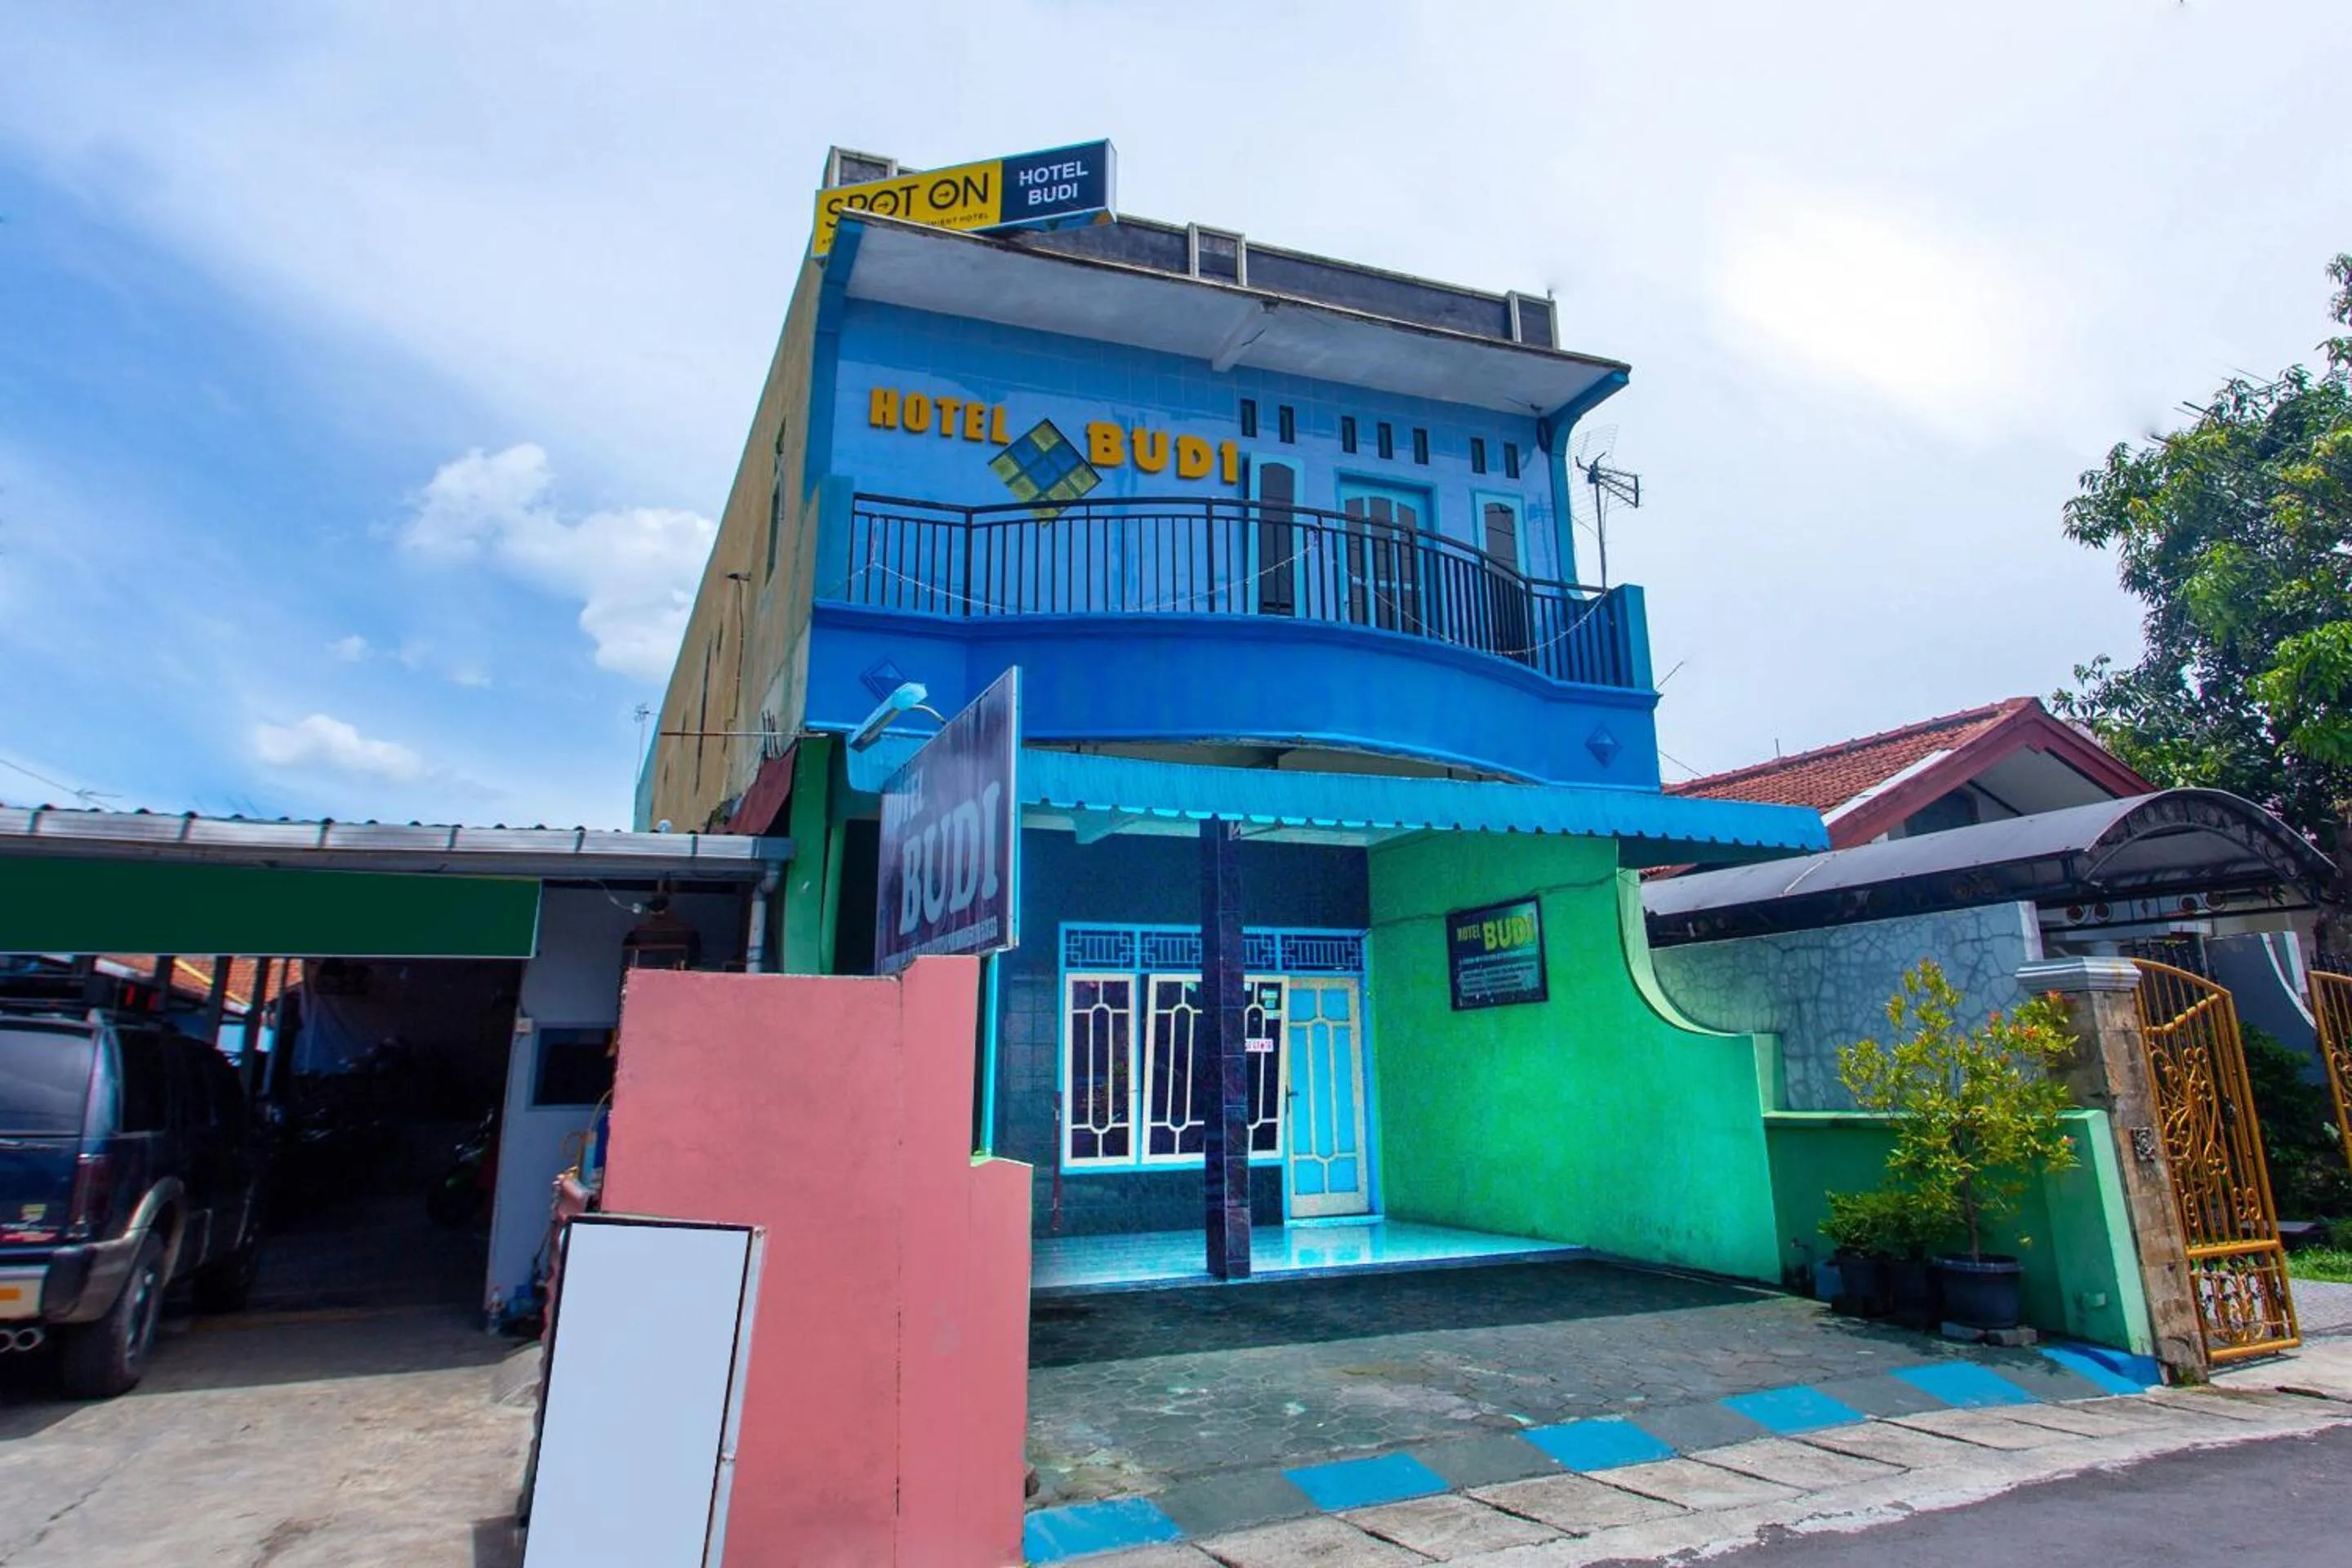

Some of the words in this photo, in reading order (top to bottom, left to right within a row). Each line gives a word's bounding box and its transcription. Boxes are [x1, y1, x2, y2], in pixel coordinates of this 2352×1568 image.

[1018, 161, 1089, 186] HOTEL
[1027, 182, 1079, 206] BUDI
[825, 185, 920, 229] SPOT
[929, 172, 989, 210] ON
[869, 386, 1010, 446] HOTEL
[1086, 421, 1239, 483] BUDI
[899, 780, 1001, 936] BUDI
[1482, 914, 1535, 951] BUDI
